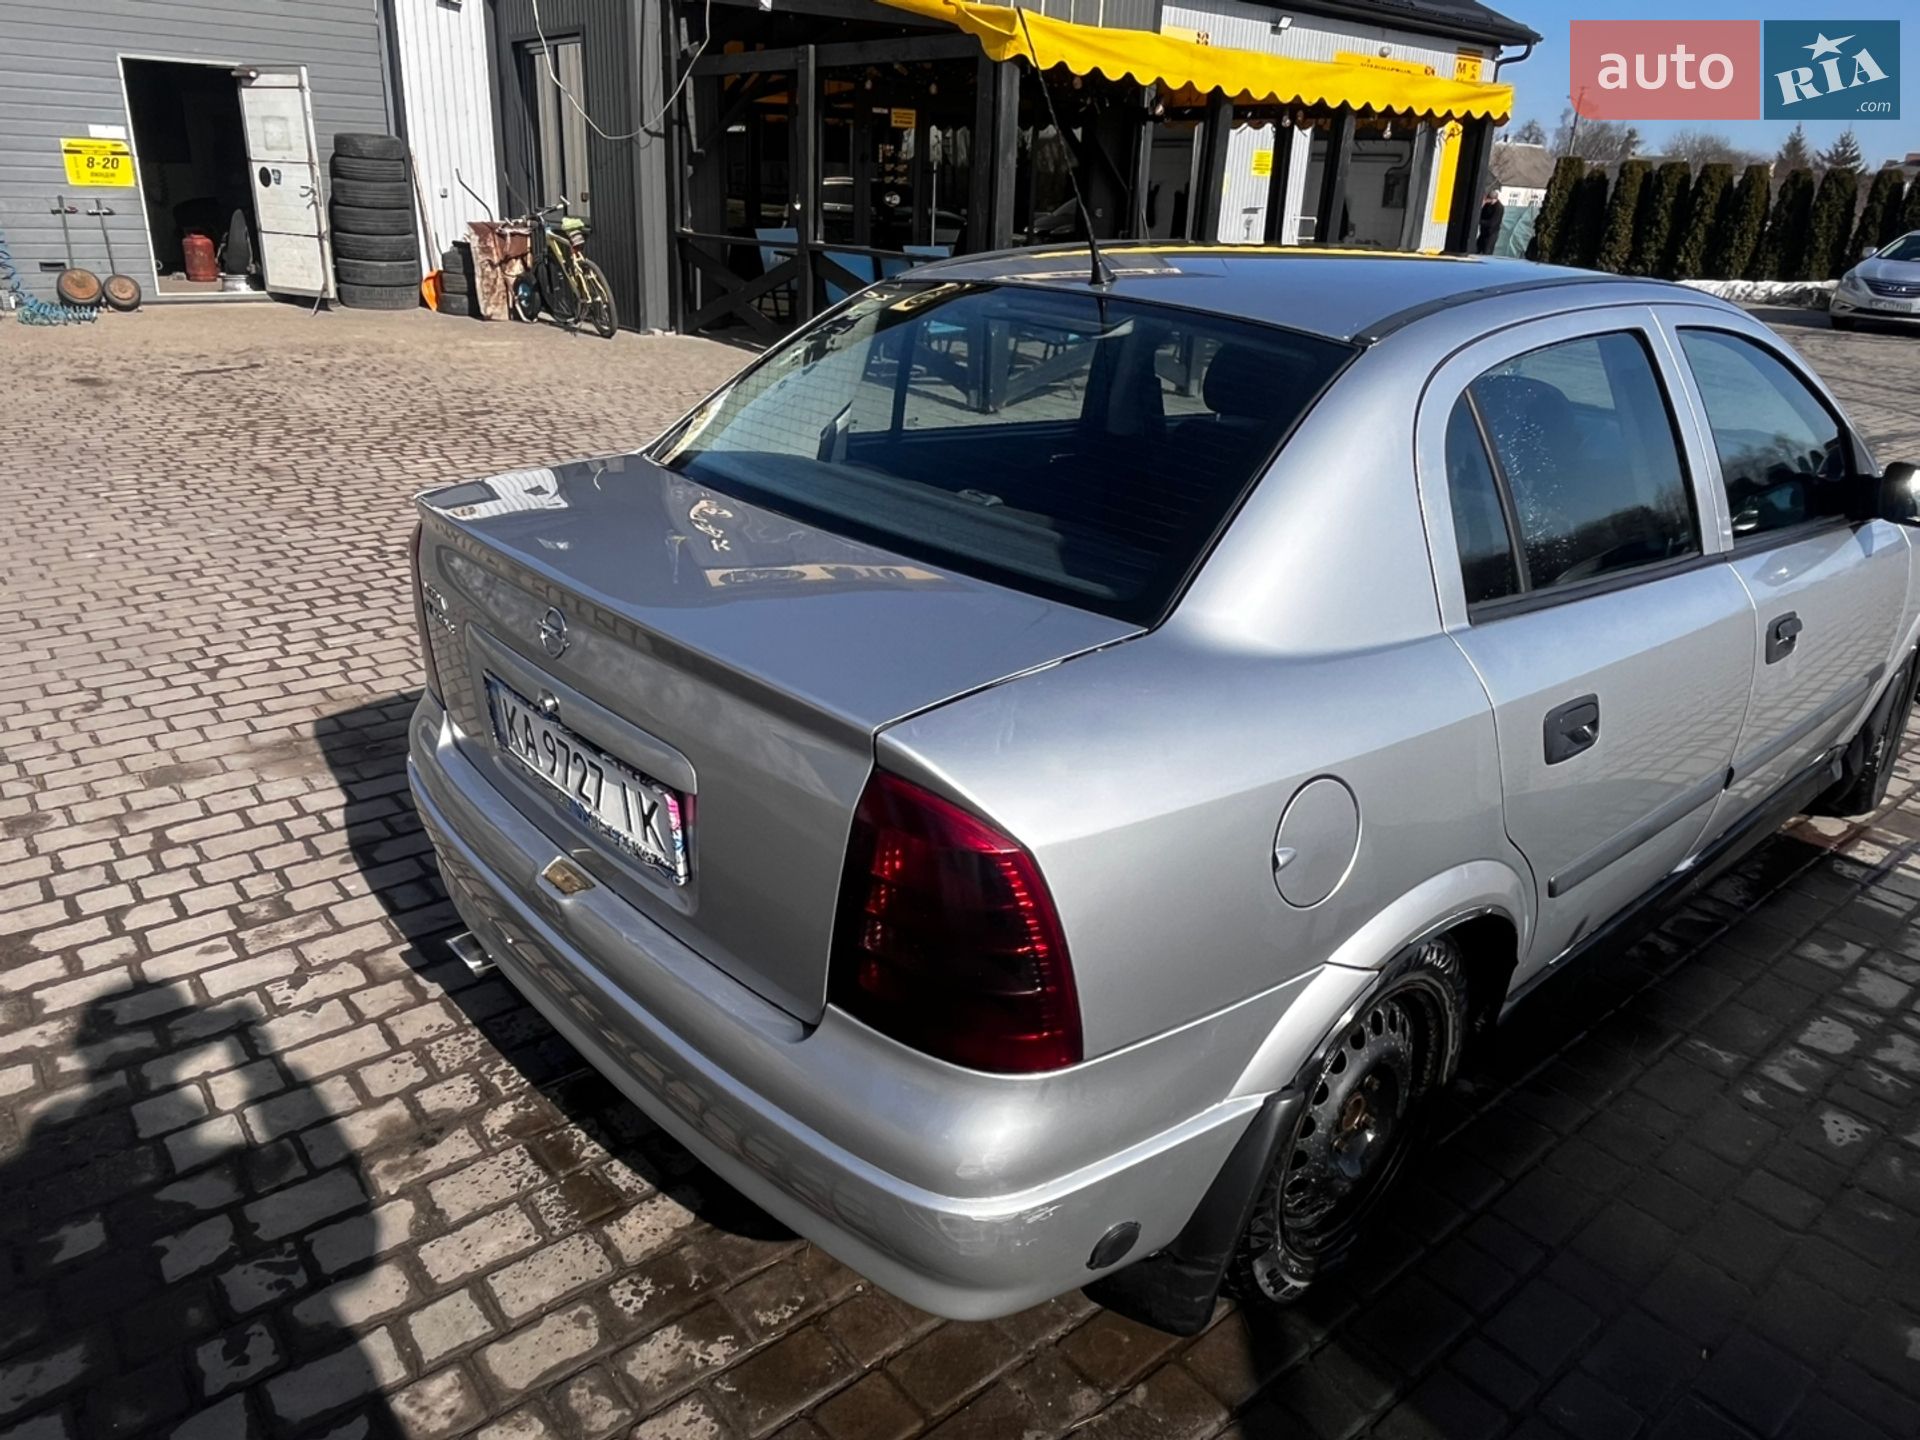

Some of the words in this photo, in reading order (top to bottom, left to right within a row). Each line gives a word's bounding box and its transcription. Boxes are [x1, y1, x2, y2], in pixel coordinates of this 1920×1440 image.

[86, 156, 120, 170] 8-20
[502, 698, 543, 768] KA
[542, 729, 604, 812] 9727
[622, 781, 667, 853] IK
